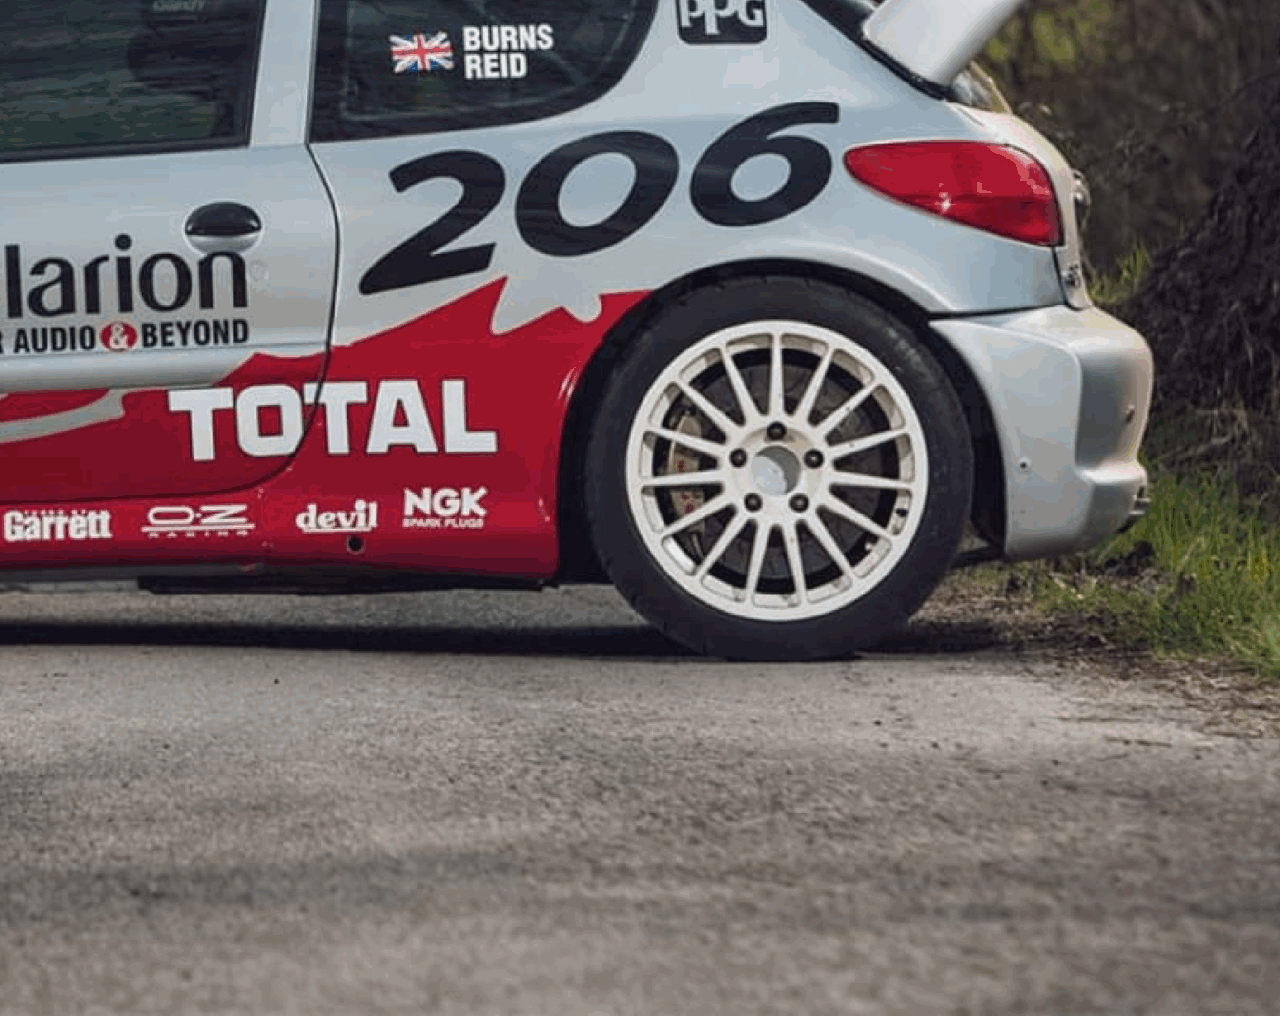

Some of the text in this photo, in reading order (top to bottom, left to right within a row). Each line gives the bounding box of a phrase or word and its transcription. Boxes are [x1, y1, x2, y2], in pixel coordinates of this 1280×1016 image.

[463, 25, 554, 51] BURNS
[464, 55, 528, 79] REID
[360, 102, 839, 295] 206
[14, 326, 96, 353] AUDIO
[141, 319, 249, 347] BEYOND
[168, 380, 498, 462] TOTAL
[296, 500, 376, 530] devil
[403, 486, 488, 516] NGK
[4, 510, 112, 541] Garrett
